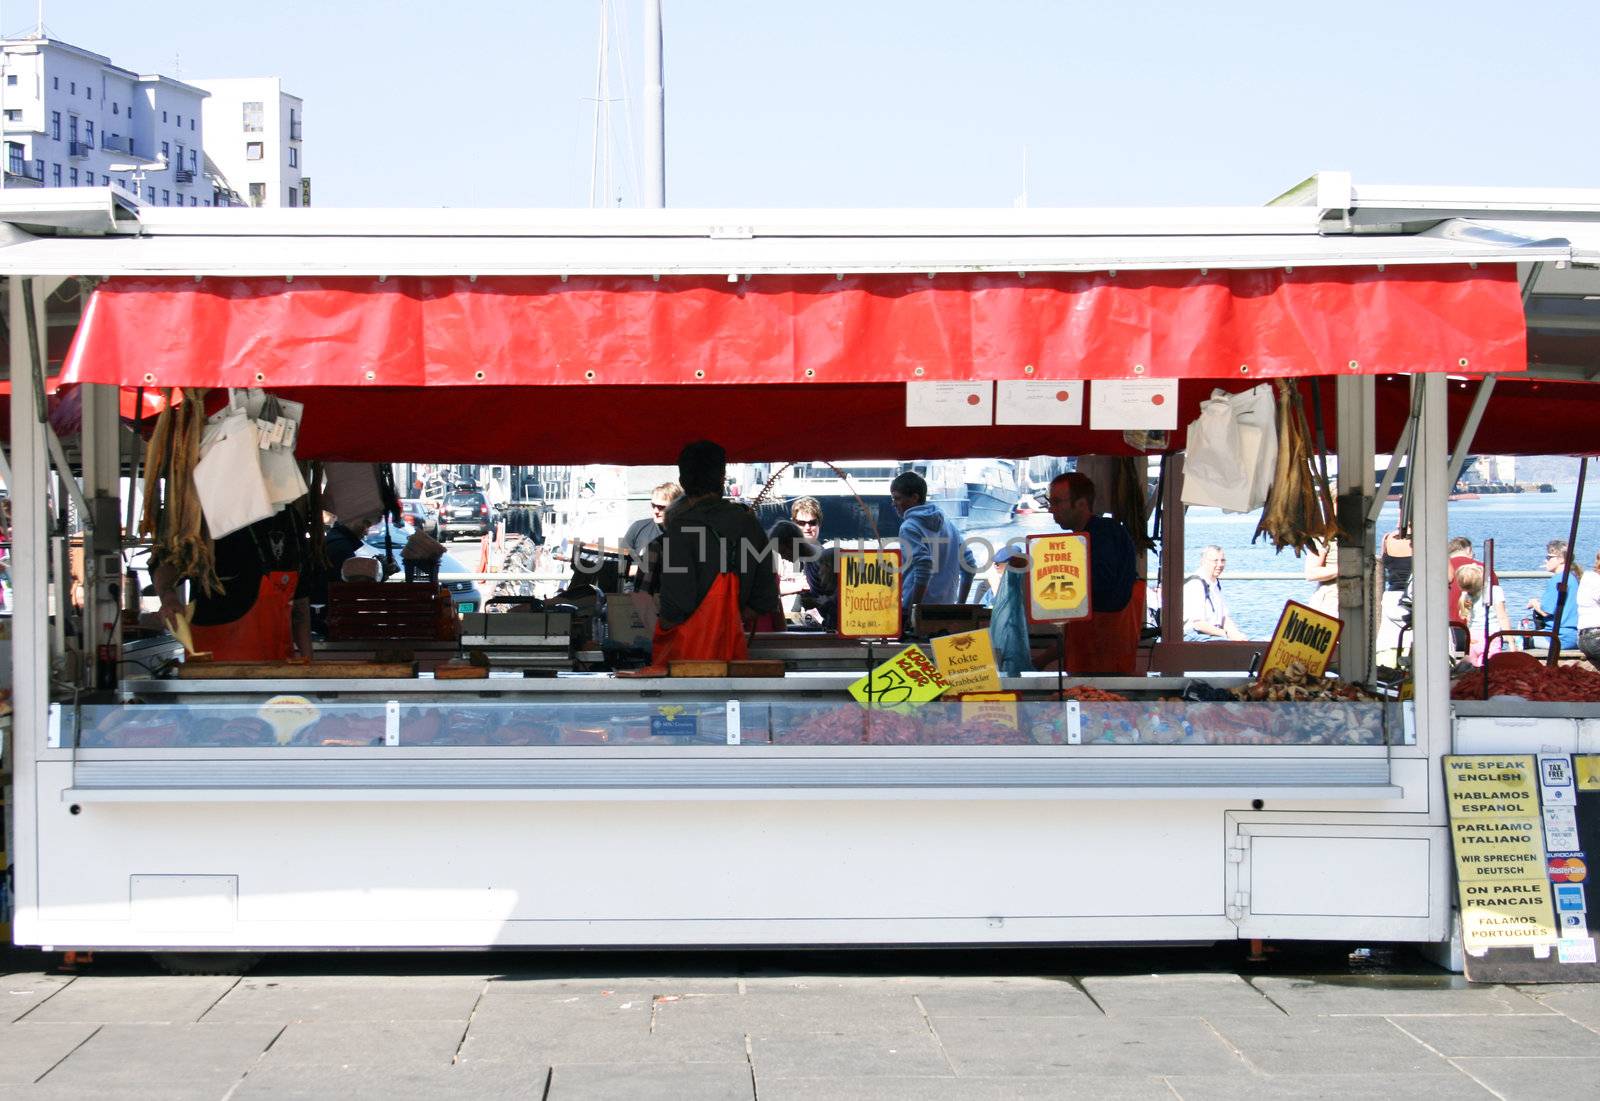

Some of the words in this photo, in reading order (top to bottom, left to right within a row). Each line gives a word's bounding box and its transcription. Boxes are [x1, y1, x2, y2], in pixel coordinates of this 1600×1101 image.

[1043, 552, 1072, 563] STORE
[846, 554, 894, 588] Nykokte
[1039, 581, 1077, 600] 45
[1282, 609, 1333, 655] Nykokte
[948, 653, 978, 666] Kokte
[1451, 762, 1473, 770] WE
[1478, 761, 1525, 769] SPEAK
[1458, 774, 1521, 782] ENGLISH
[1548, 770, 1565, 778] FREE
[1453, 791, 1530, 800] HABLAMOS
[1462, 804, 1525, 812] ESPANOL
[1457, 823, 1533, 832] PARLIAMO
[1462, 835, 1531, 844] ITALIANO
[1461, 855, 1480, 863] WIR
[1483, 854, 1537, 863] SPRECHEN
[1477, 866, 1525, 875] DEUTSCH
[1466, 886, 1489, 895] ON
[1493, 884, 1541, 894] PARLE
[1467, 897, 1543, 907] FRANCAIS
[1479, 916, 1537, 926] FALAMOS
